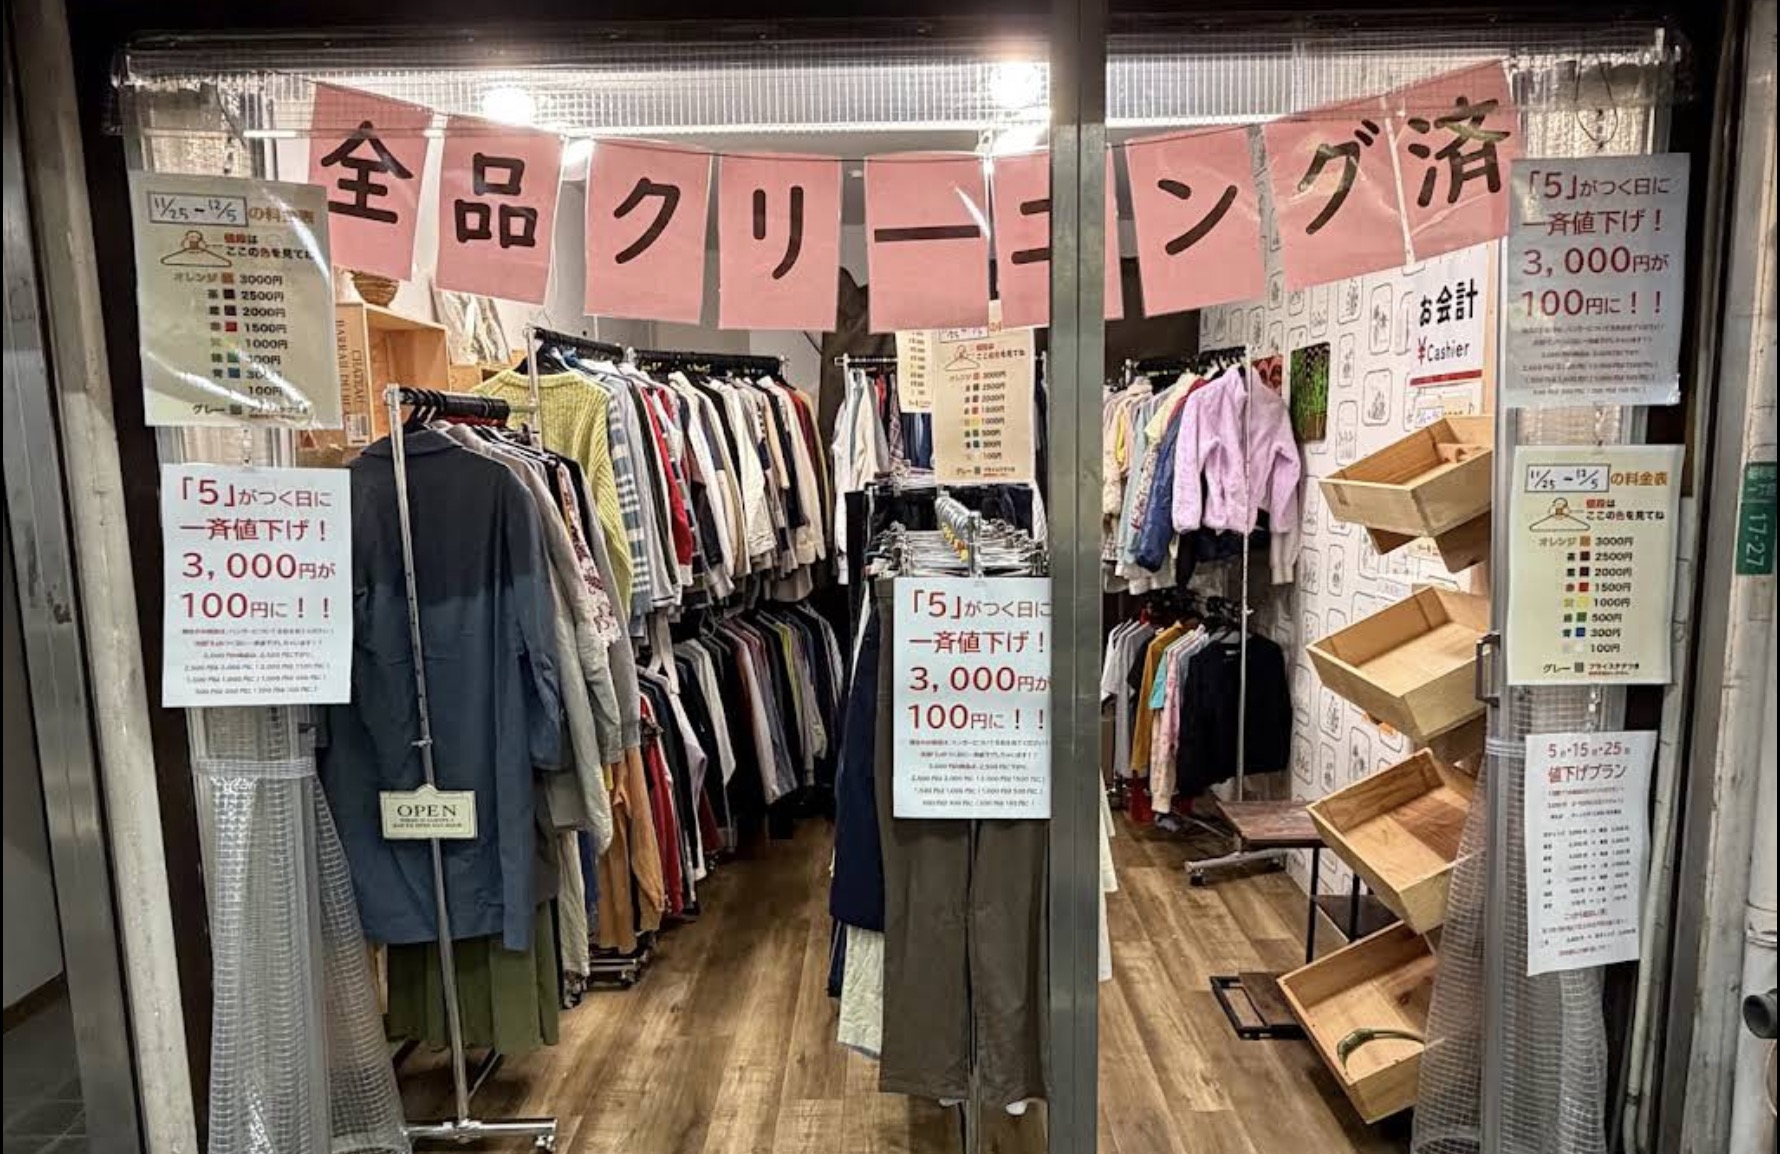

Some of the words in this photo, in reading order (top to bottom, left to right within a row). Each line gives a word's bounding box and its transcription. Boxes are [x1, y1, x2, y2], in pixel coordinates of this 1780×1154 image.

[1529, 170, 1671, 200] 「5」がつく日に
[1522, 208, 1662, 236] 一斉値下げ！
[173, 272, 218, 284] オレンジ
[239, 274, 283, 286] 3000円
[241, 290, 284, 302] 2500円
[1420, 278, 1479, 327] お会計
[243, 306, 286, 318] 2000円
[245, 322, 287, 334] 1500円
[246, 338, 288, 350] 1000円
[193, 404, 225, 415] グレー
[1610, 471, 1668, 486] の料金表
[182, 477, 333, 508] 「5」がつく日に
[180, 518, 326, 541] 一斉値下げ！
[1595, 537, 1634, 547] 3000円
[1745, 512, 1768, 566] 17-27
[1594, 552, 1633, 562] 2500円
[1594, 567, 1632, 577] 2000円
[1594, 583, 1632, 592] 1500円
[913, 589, 1052, 619] 「5」がつく日に
[1593, 598, 1631, 608] 1000円
[1591, 613, 1623, 623] 500円
[1589, 627, 1622, 637] 300円
[908, 631, 1044, 655] 一斉値下げ！
[1590, 643, 1621, 653] 100円
[1543, 663, 1571, 674] グレー
[1548, 763, 1627, 784] 値下げプラン
[397, 804, 457, 818] OPEN
